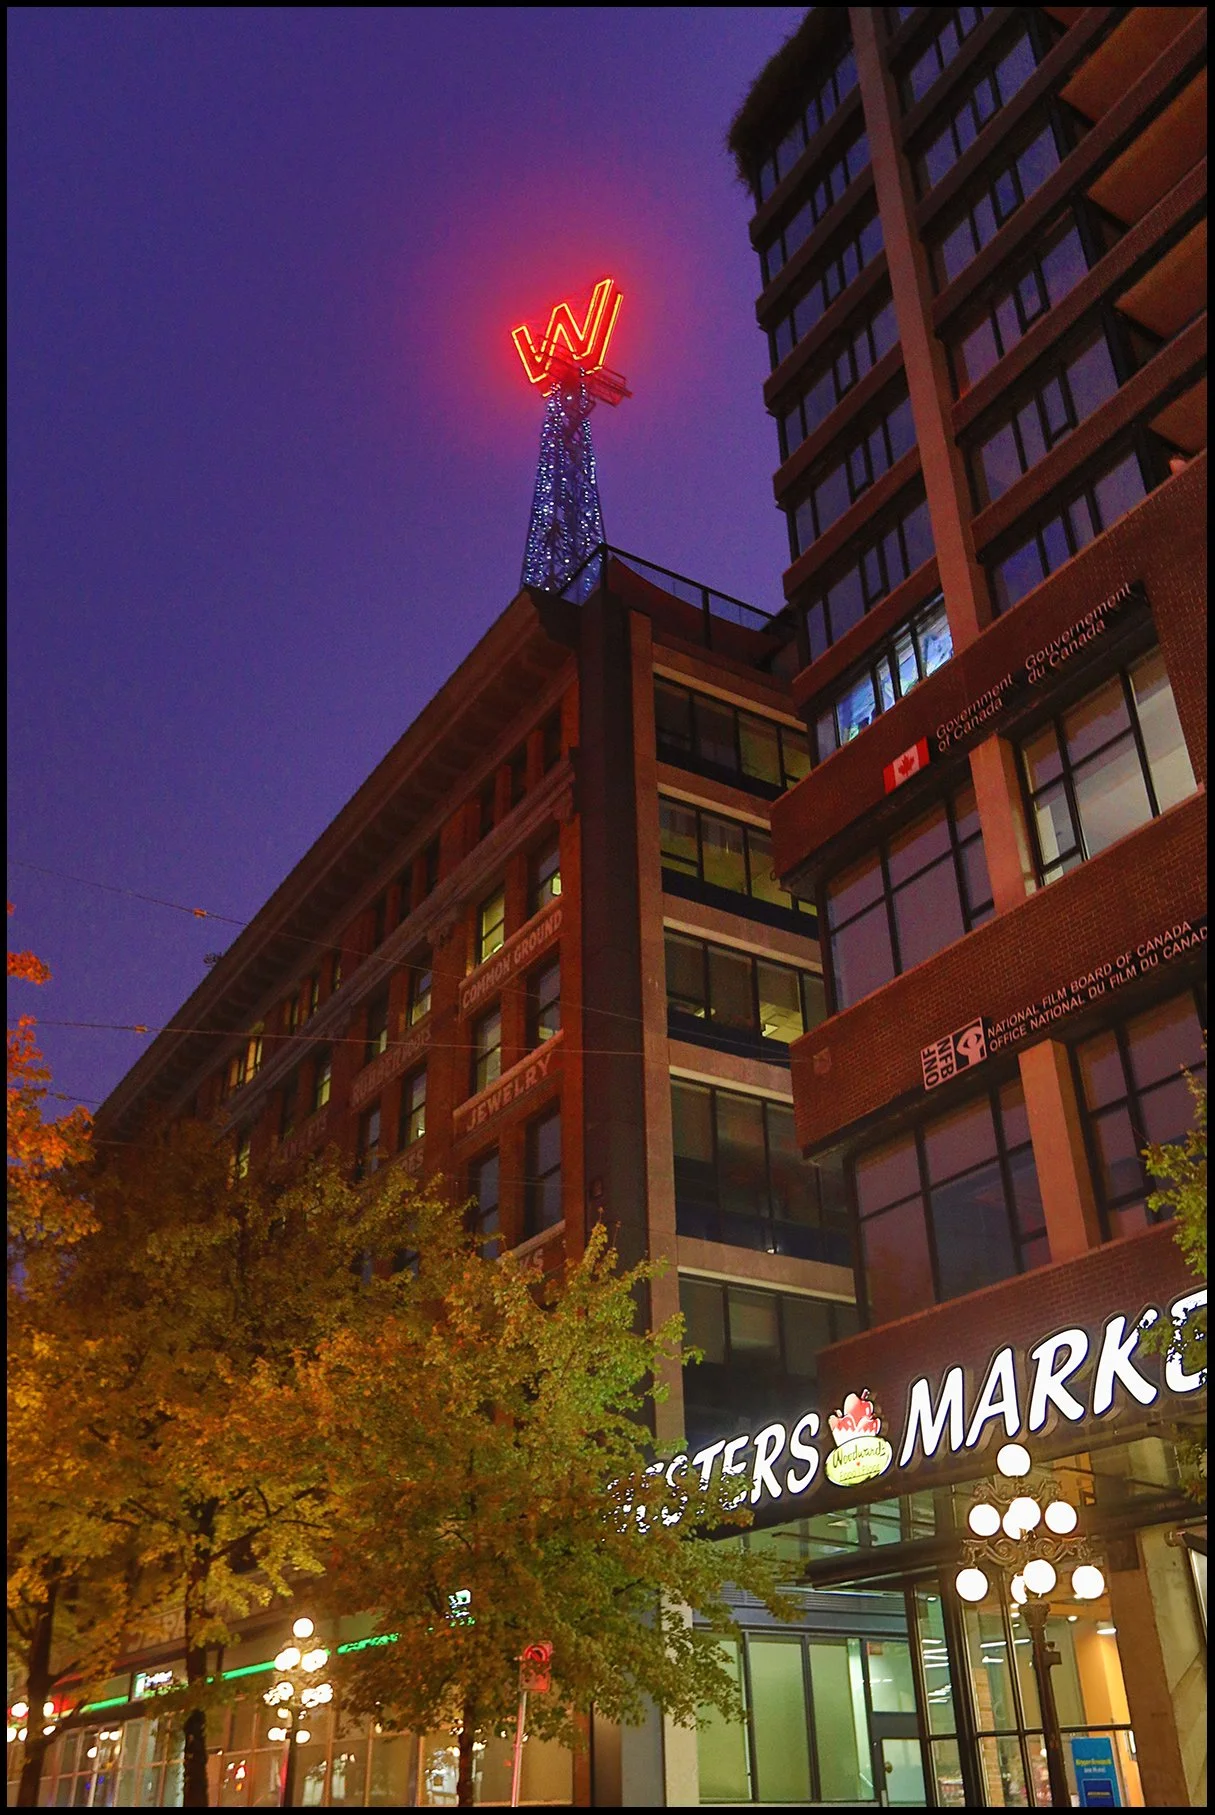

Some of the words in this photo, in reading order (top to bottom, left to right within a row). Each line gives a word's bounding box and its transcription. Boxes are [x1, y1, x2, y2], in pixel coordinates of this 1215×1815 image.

[511, 278, 616, 386] W
[1025, 582, 1131, 670] Gouvernement
[1028, 665, 1045, 684] du
[1049, 619, 1105, 667] Canada
[936, 672, 1013, 739] Government
[938, 734, 950, 752] of
[953, 698, 1003, 739] Canada
[462, 954, 512, 1009] COMMON
[514, 909, 563, 964] GROUND
[987, 1004, 1039, 1038] NATIONAL
[1042, 986, 1067, 1009] FILM
[1070, 963, 1112, 993] BOARD
[1116, 951, 1132, 969] OF
[1137, 921, 1192, 957] CANADA
[989, 1023, 1027, 1052] OFFICE
[1030, 994, 1085, 1030] NATIONAL
[1088, 981, 1105, 999] DU
[1109, 965, 1137, 989] FILM
[1140, 953, 1158, 972] DU
[465, 1053, 552, 1132] JEWELRY
[937, 1037, 954, 1079] NFB
[602, 1412, 820, 1538] STERS
